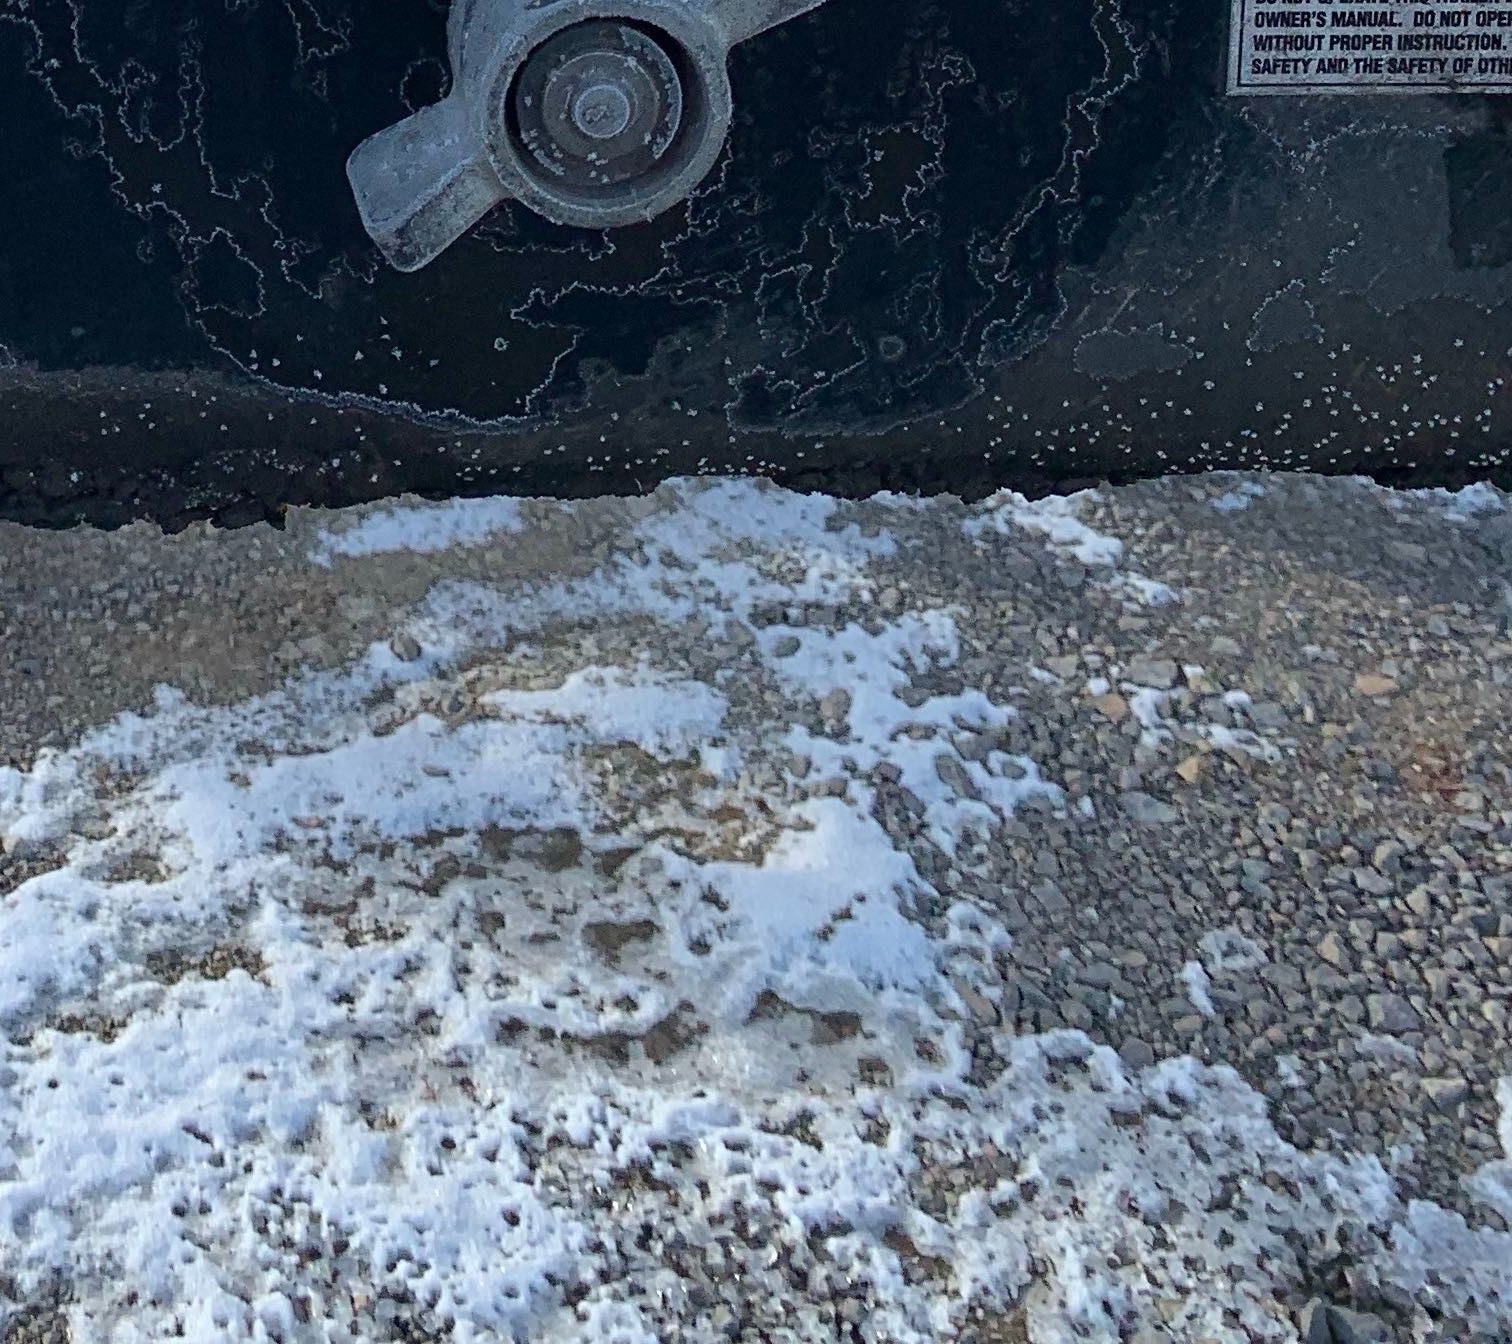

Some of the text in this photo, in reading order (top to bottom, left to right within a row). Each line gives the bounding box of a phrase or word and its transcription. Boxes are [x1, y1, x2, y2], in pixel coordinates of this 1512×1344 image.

[1331, 11, 1402, 28] MANUAL.
[1413, 11, 1436, 28] DO
[1439, 11, 1470, 28] NOT
[1254, 33, 1507, 51] WITHOUT PROPER INSTRUCTION.
[1251, 58, 1312, 74] SAFETY
[1316, 58, 1349, 74] AND
[1354, 58, 1384, 74] THE
[1388, 57, 1449, 74] SAFETY
[1453, 57, 1474, 74] OF
